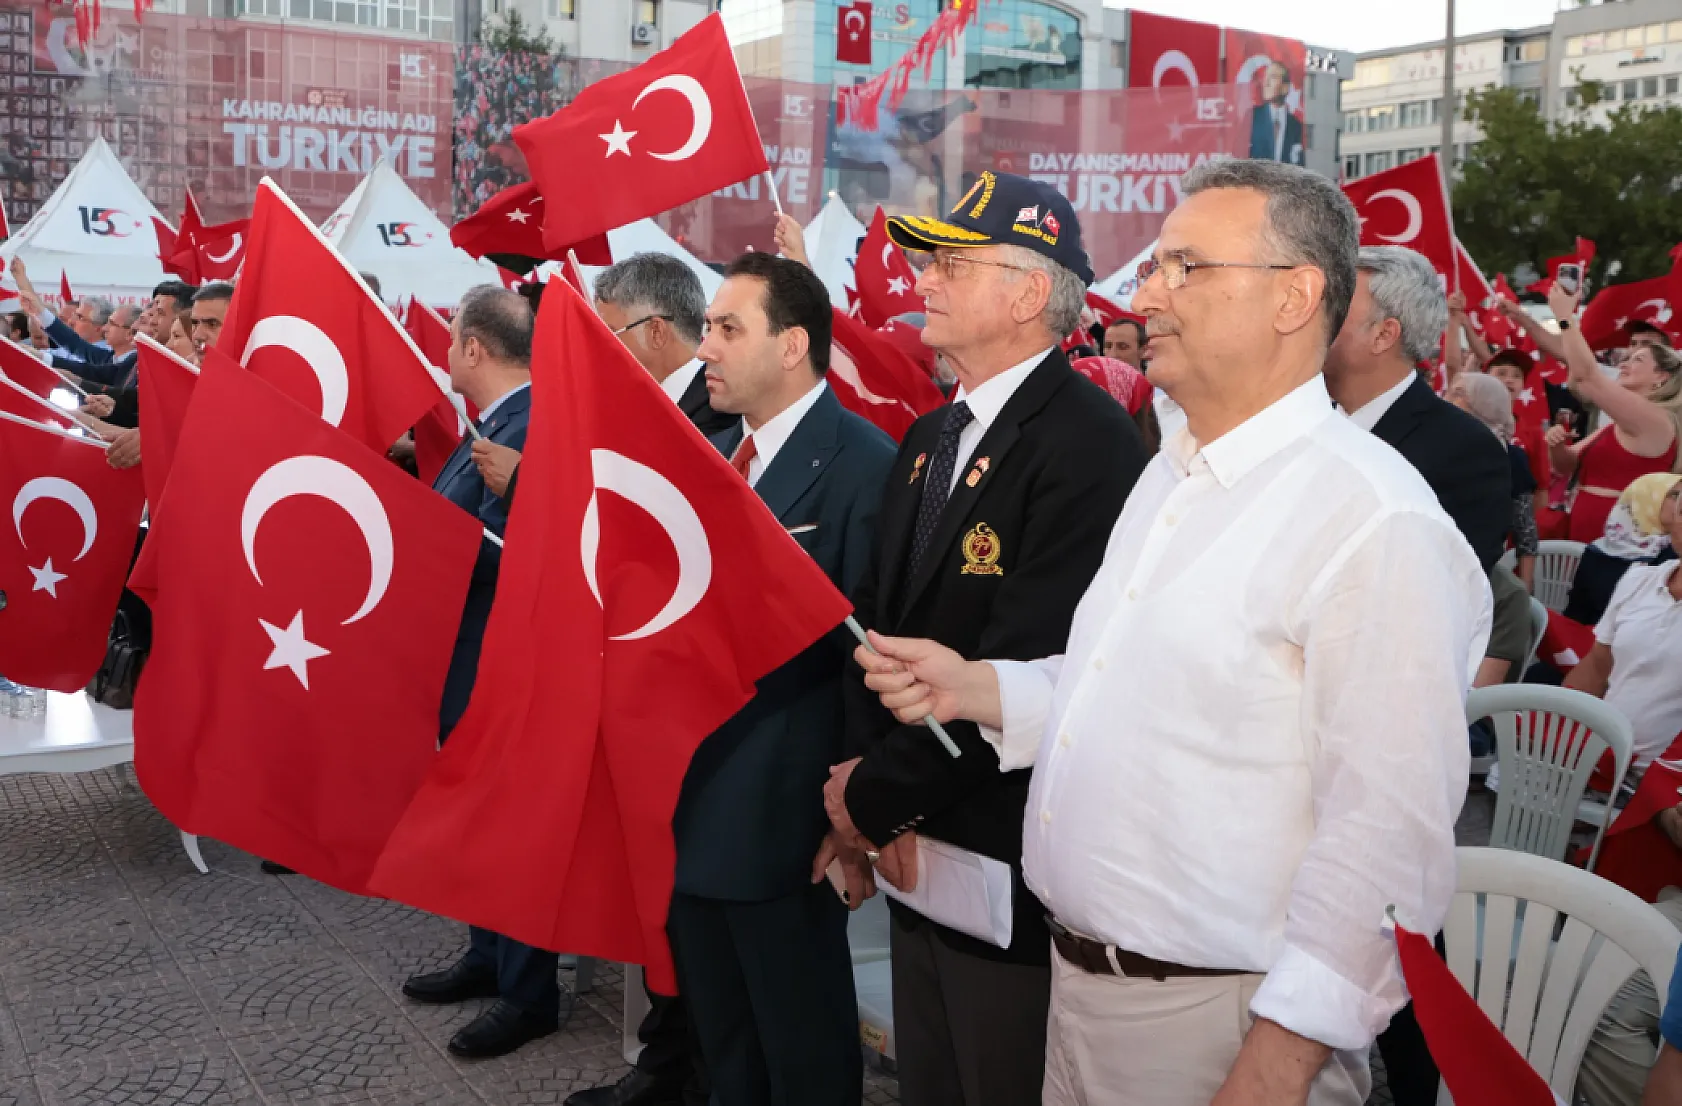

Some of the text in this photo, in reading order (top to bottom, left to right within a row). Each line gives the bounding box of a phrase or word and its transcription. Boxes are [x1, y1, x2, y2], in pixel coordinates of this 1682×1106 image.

[223, 97, 397, 129] KAHRAMANLIĞIN
[402, 113, 436, 133] ADI
[1029, 152, 1191, 175] DAYANIŞMANIN
